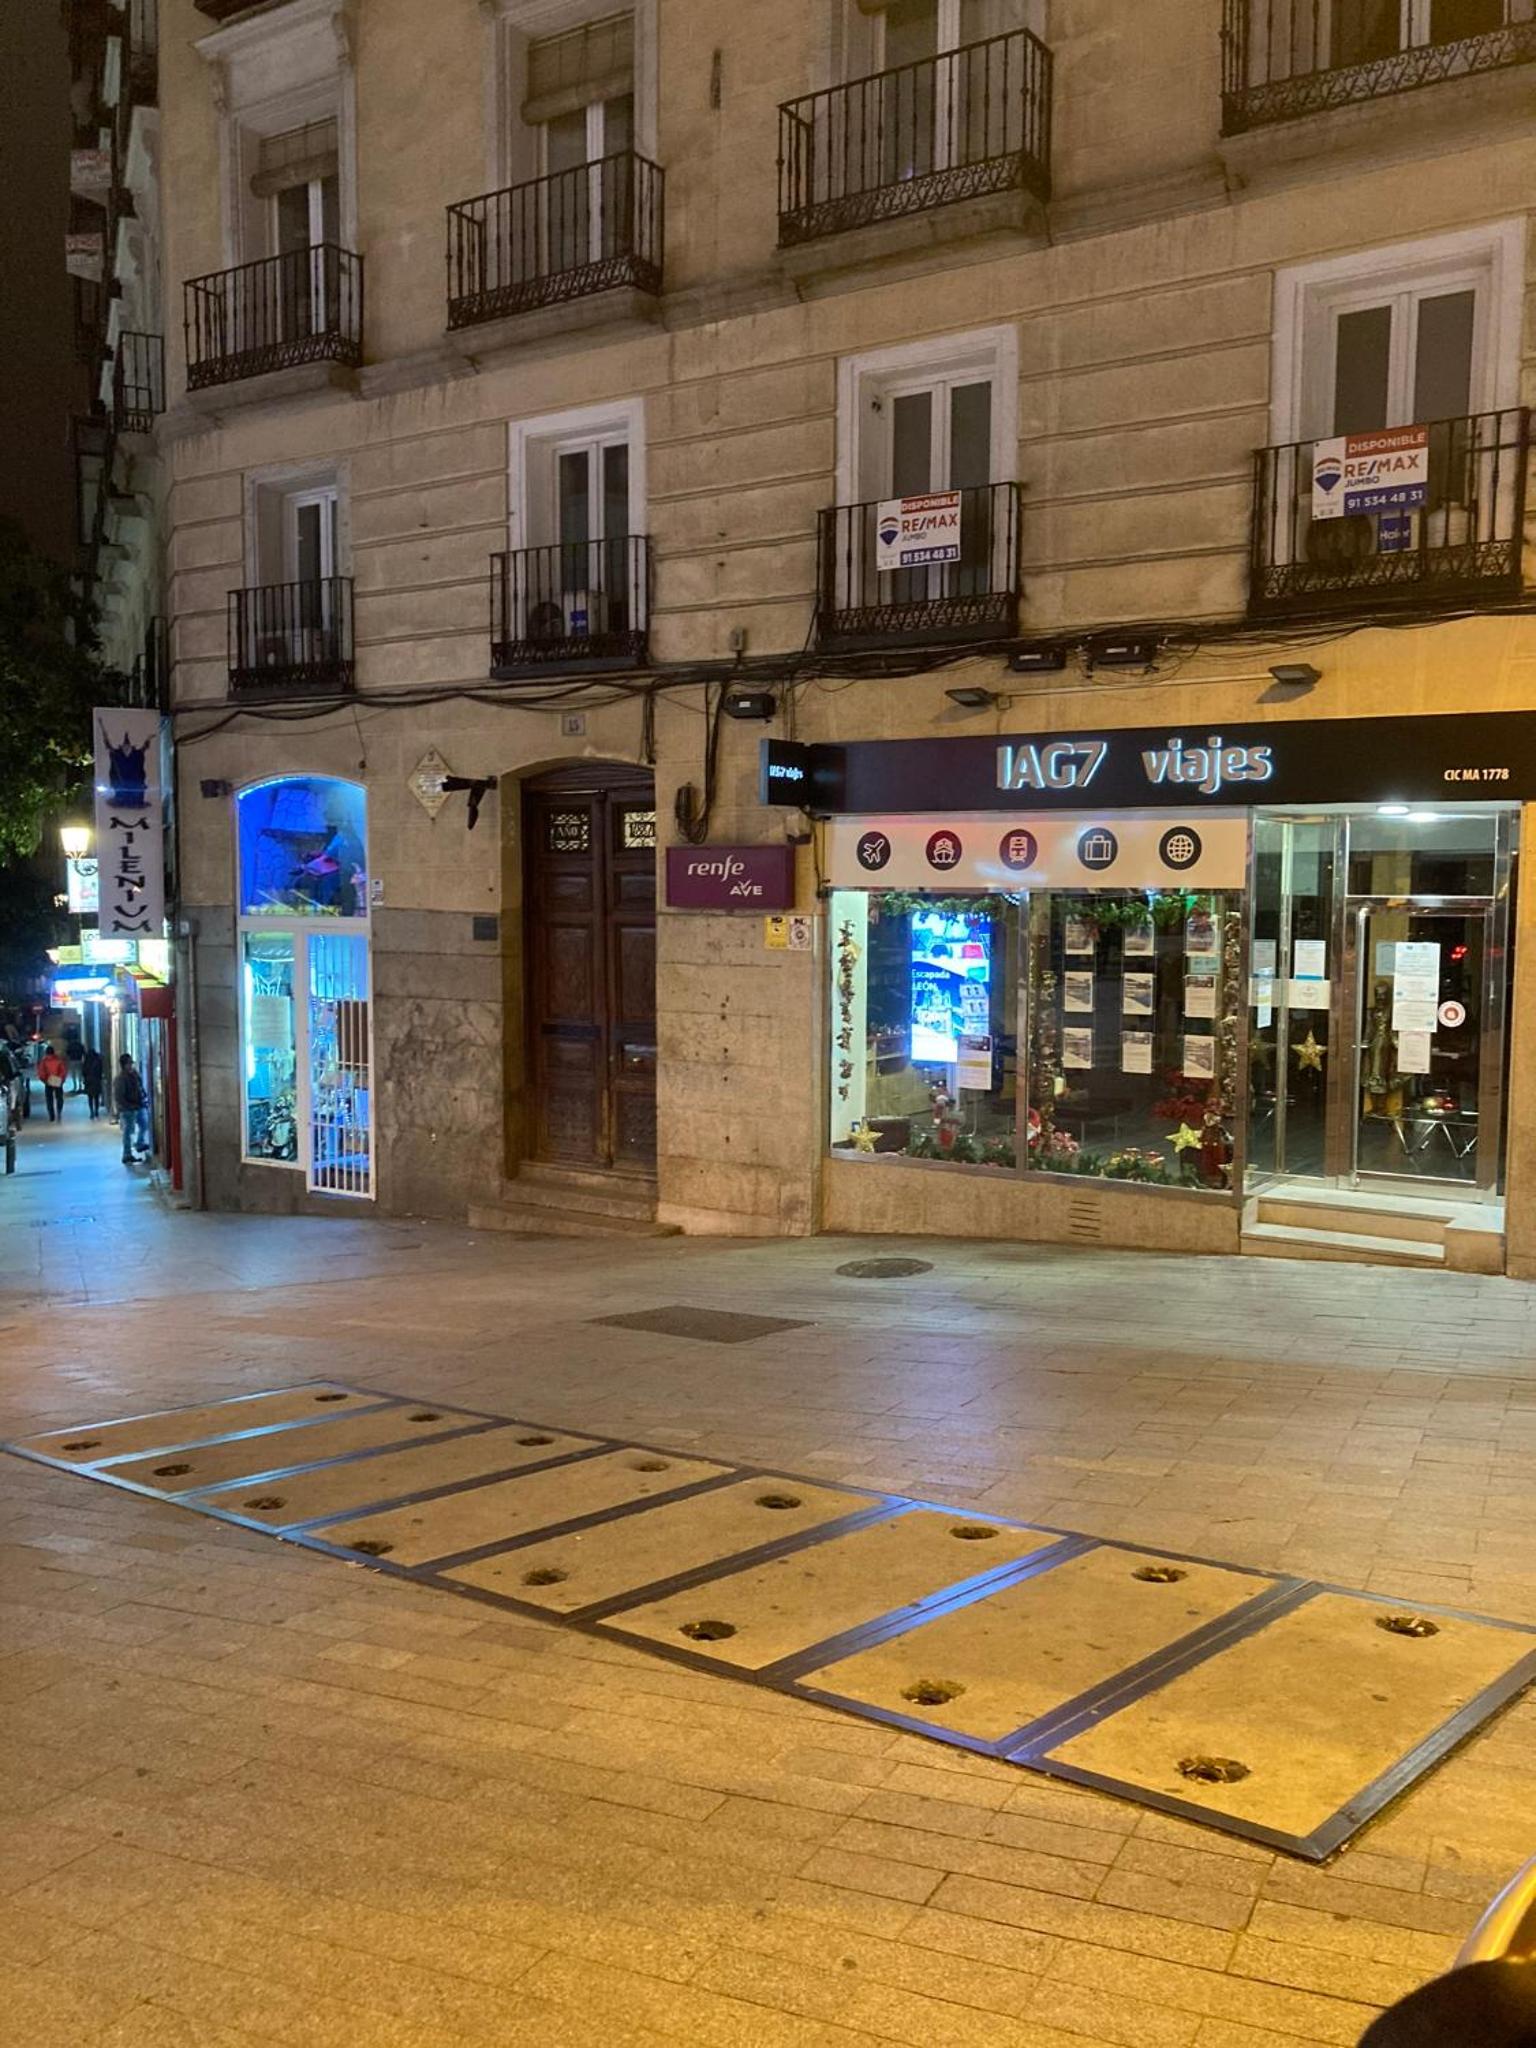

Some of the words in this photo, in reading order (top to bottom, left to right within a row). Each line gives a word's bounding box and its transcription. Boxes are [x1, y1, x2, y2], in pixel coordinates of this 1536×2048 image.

[1348, 432, 1425, 454] DISPONIBLE
[1344, 454, 1419, 478] RE/MAX
[1344, 476, 1380, 488] JUMBO
[1348, 498, 1360, 508] 91
[1364, 495, 1386, 506] 534
[1390, 492, 1406, 503] 48
[1410, 490, 1423, 500] 31
[902, 513, 957, 533] RE/MAX
[902, 553, 913, 564] 91
[914, 551, 931, 562] 534
[945, 547, 957, 558] 31
[996, 742, 1107, 789] IAG7
[1141, 736, 1272, 794] viajes
[1444, 769, 1462, 780] CIC
[1462, 769, 1480, 780] MA
[1482, 768, 1509, 780] 1778
[109, 817, 152, 932] MILENIUM
[687, 854, 745, 882] renfe
[730, 879, 763, 897] AVE
[912, 969, 951, 980] Escapada
